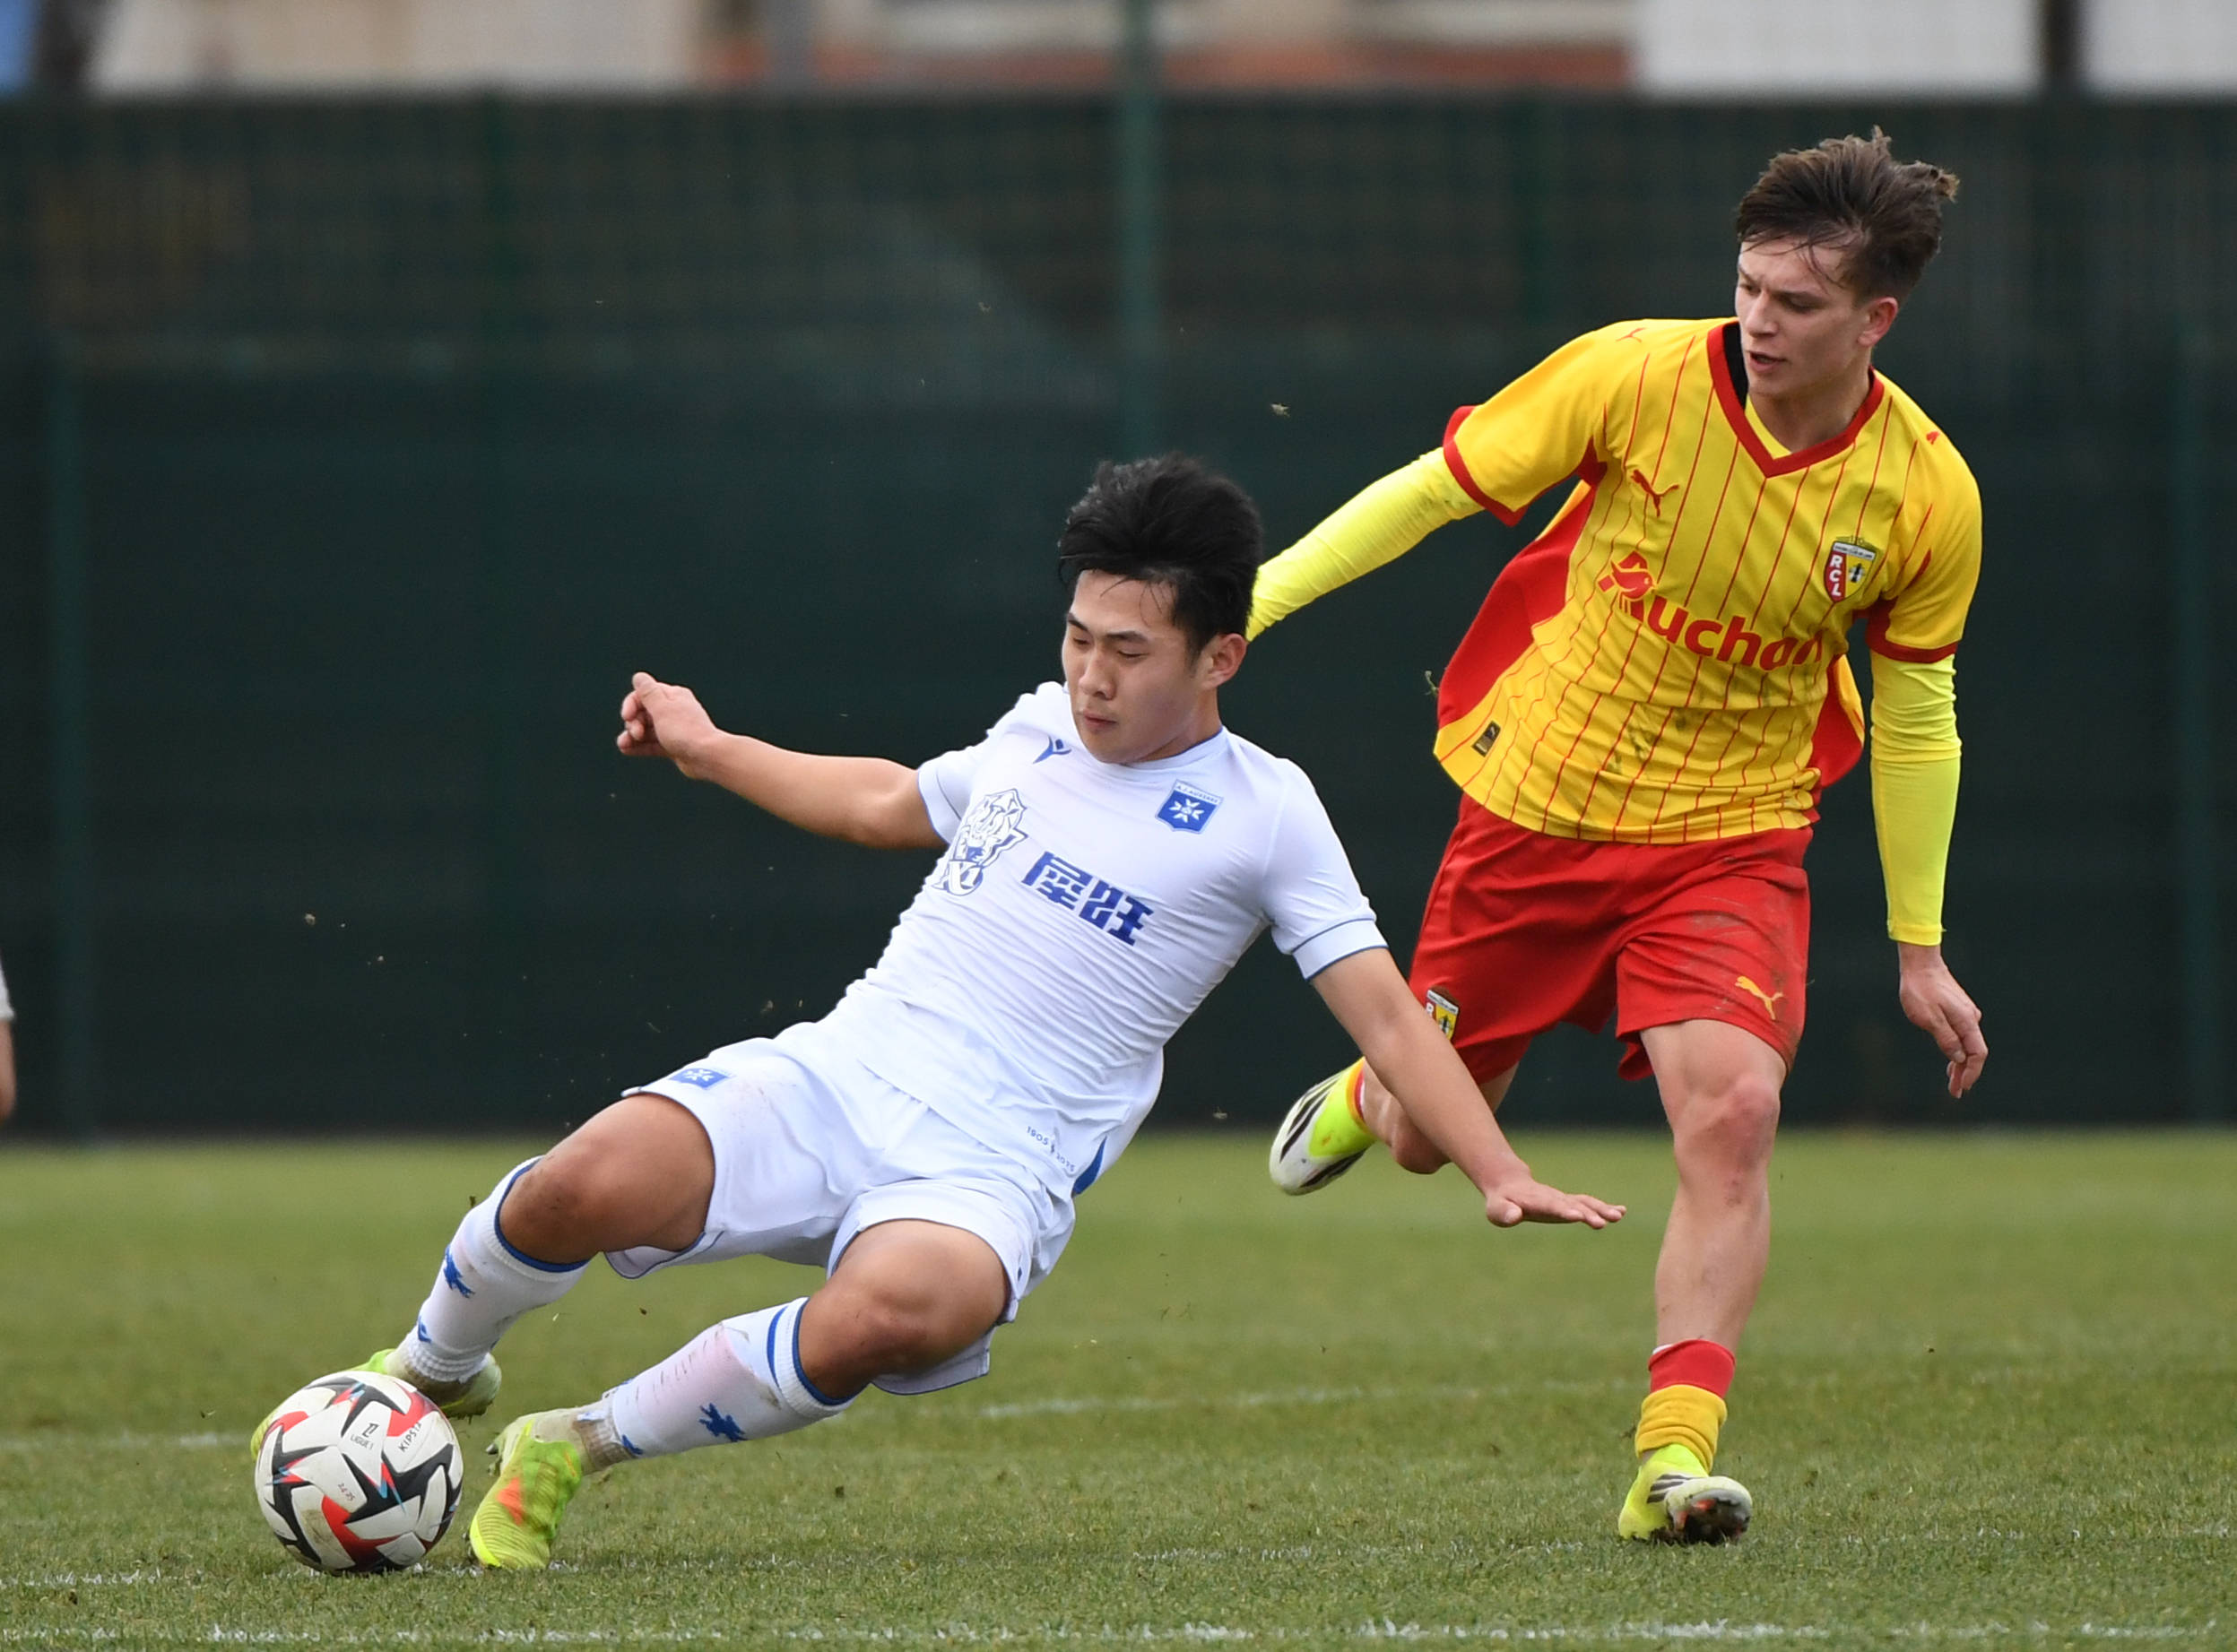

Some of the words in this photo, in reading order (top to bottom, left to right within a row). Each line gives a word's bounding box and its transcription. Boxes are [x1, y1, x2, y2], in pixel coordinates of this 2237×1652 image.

[1829, 554, 1844, 597] RCL
[1599, 550, 1823, 670] Auchan
[398, 1422, 421, 1453] KIPSTA
